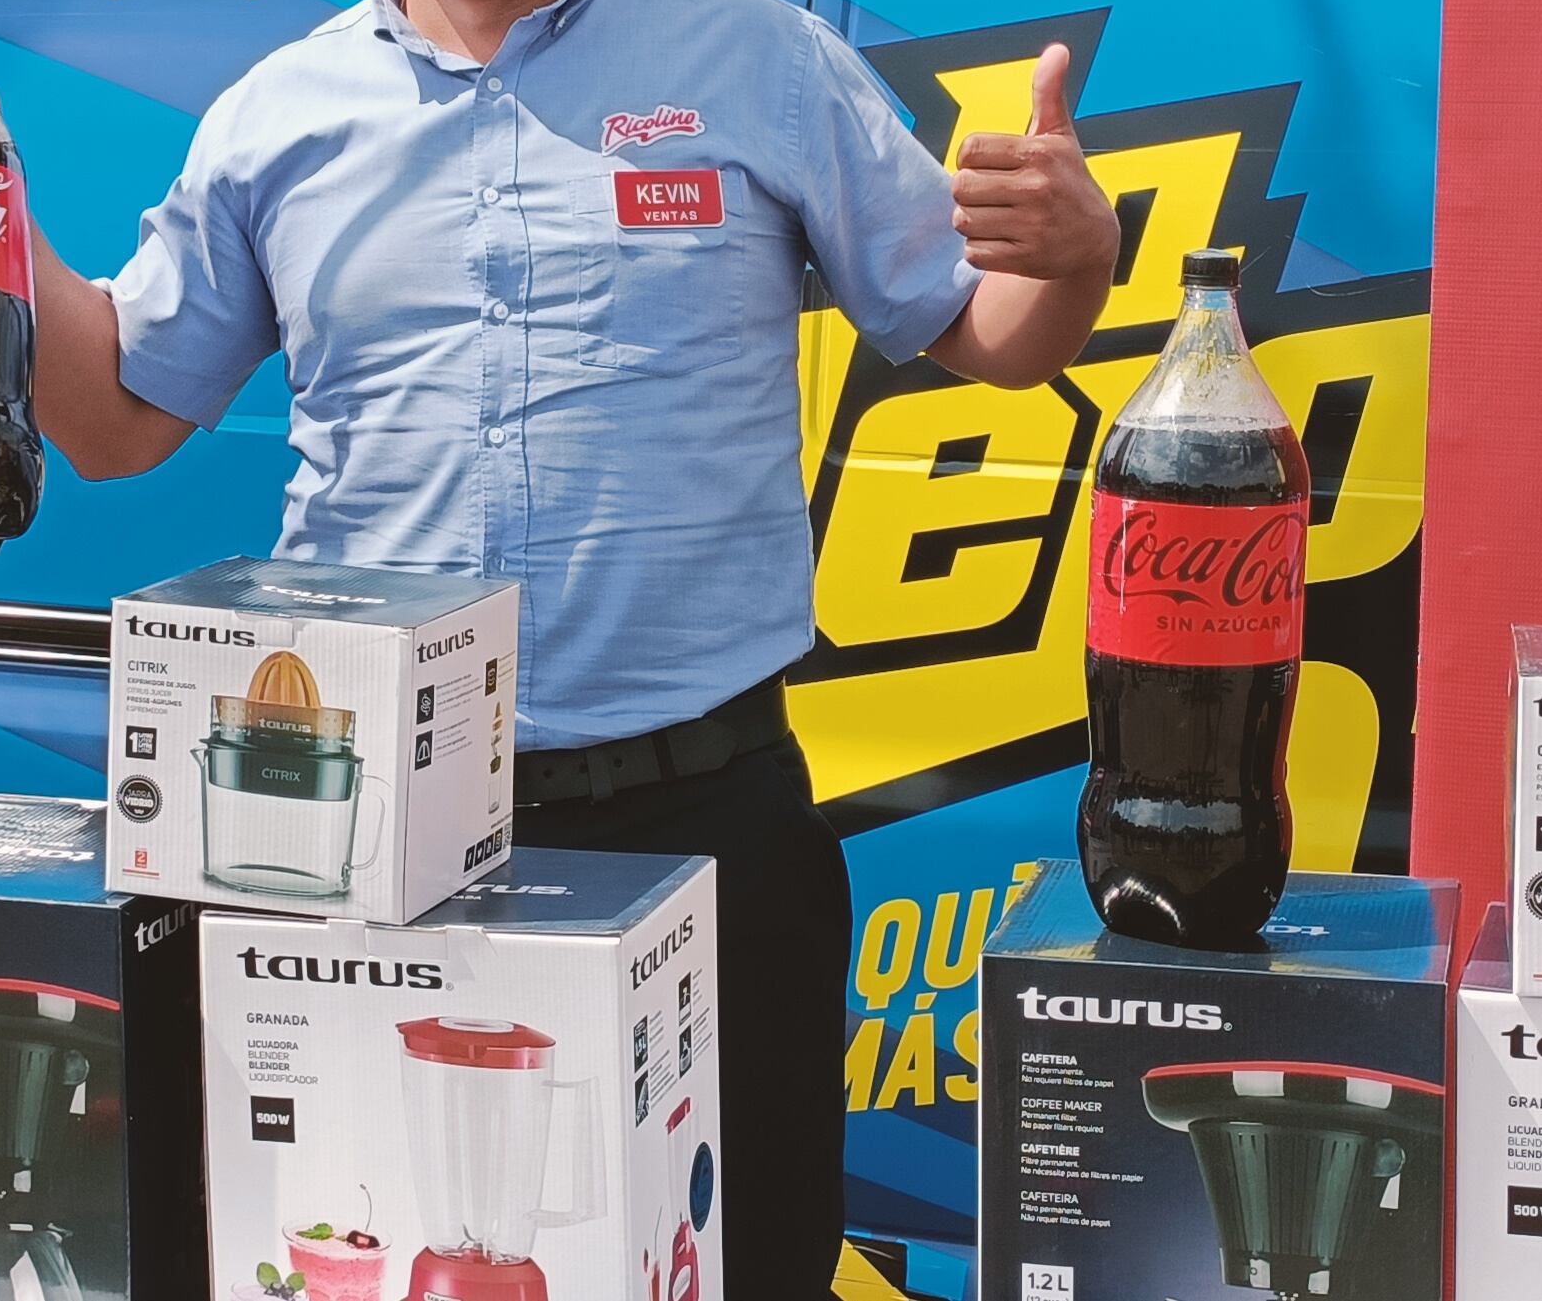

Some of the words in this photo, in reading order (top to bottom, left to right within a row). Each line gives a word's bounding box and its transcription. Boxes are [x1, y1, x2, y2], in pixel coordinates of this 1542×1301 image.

[605, 106, 695, 146] Ricolino
[636, 183, 700, 204] KEVIN
[643, 211, 698, 222] VENTAS
[1156, 616, 1192, 631] SIN
[1202, 614, 1282, 633] AZÚCAR
[126, 615, 255, 647] taurus
[416, 628, 474, 663] taurus
[128, 660, 168, 674] CITRIX
[259, 717, 311, 733] taurus
[261, 767, 301, 782] CITRIX
[630, 913, 694, 991] taurus
[237, 947, 443, 990] taurus
[1016, 987, 1222, 1031] taurus
[246, 1013, 309, 1027] GRANADA
[247, 1040, 298, 1050] LICUADORA
[248, 1050, 290, 1061] BLENDER
[1021, 1053, 1077, 1065] CAFETERA
[249, 1061, 290, 1071] BLENDER
[249, 1073, 319, 1085] LIQUIDIFICADOR
[1022, 1098, 1062, 1110] COFFEE
[1064, 1100, 1102, 1112] MAKER
[1021, 1143, 1080, 1157] CAFETIÈRE
[1021, 1191, 1078, 1204] CAFETEIRA
[1028, 1272, 1053, 1290] 1.2
[1058, 1274, 1069, 1292] L
